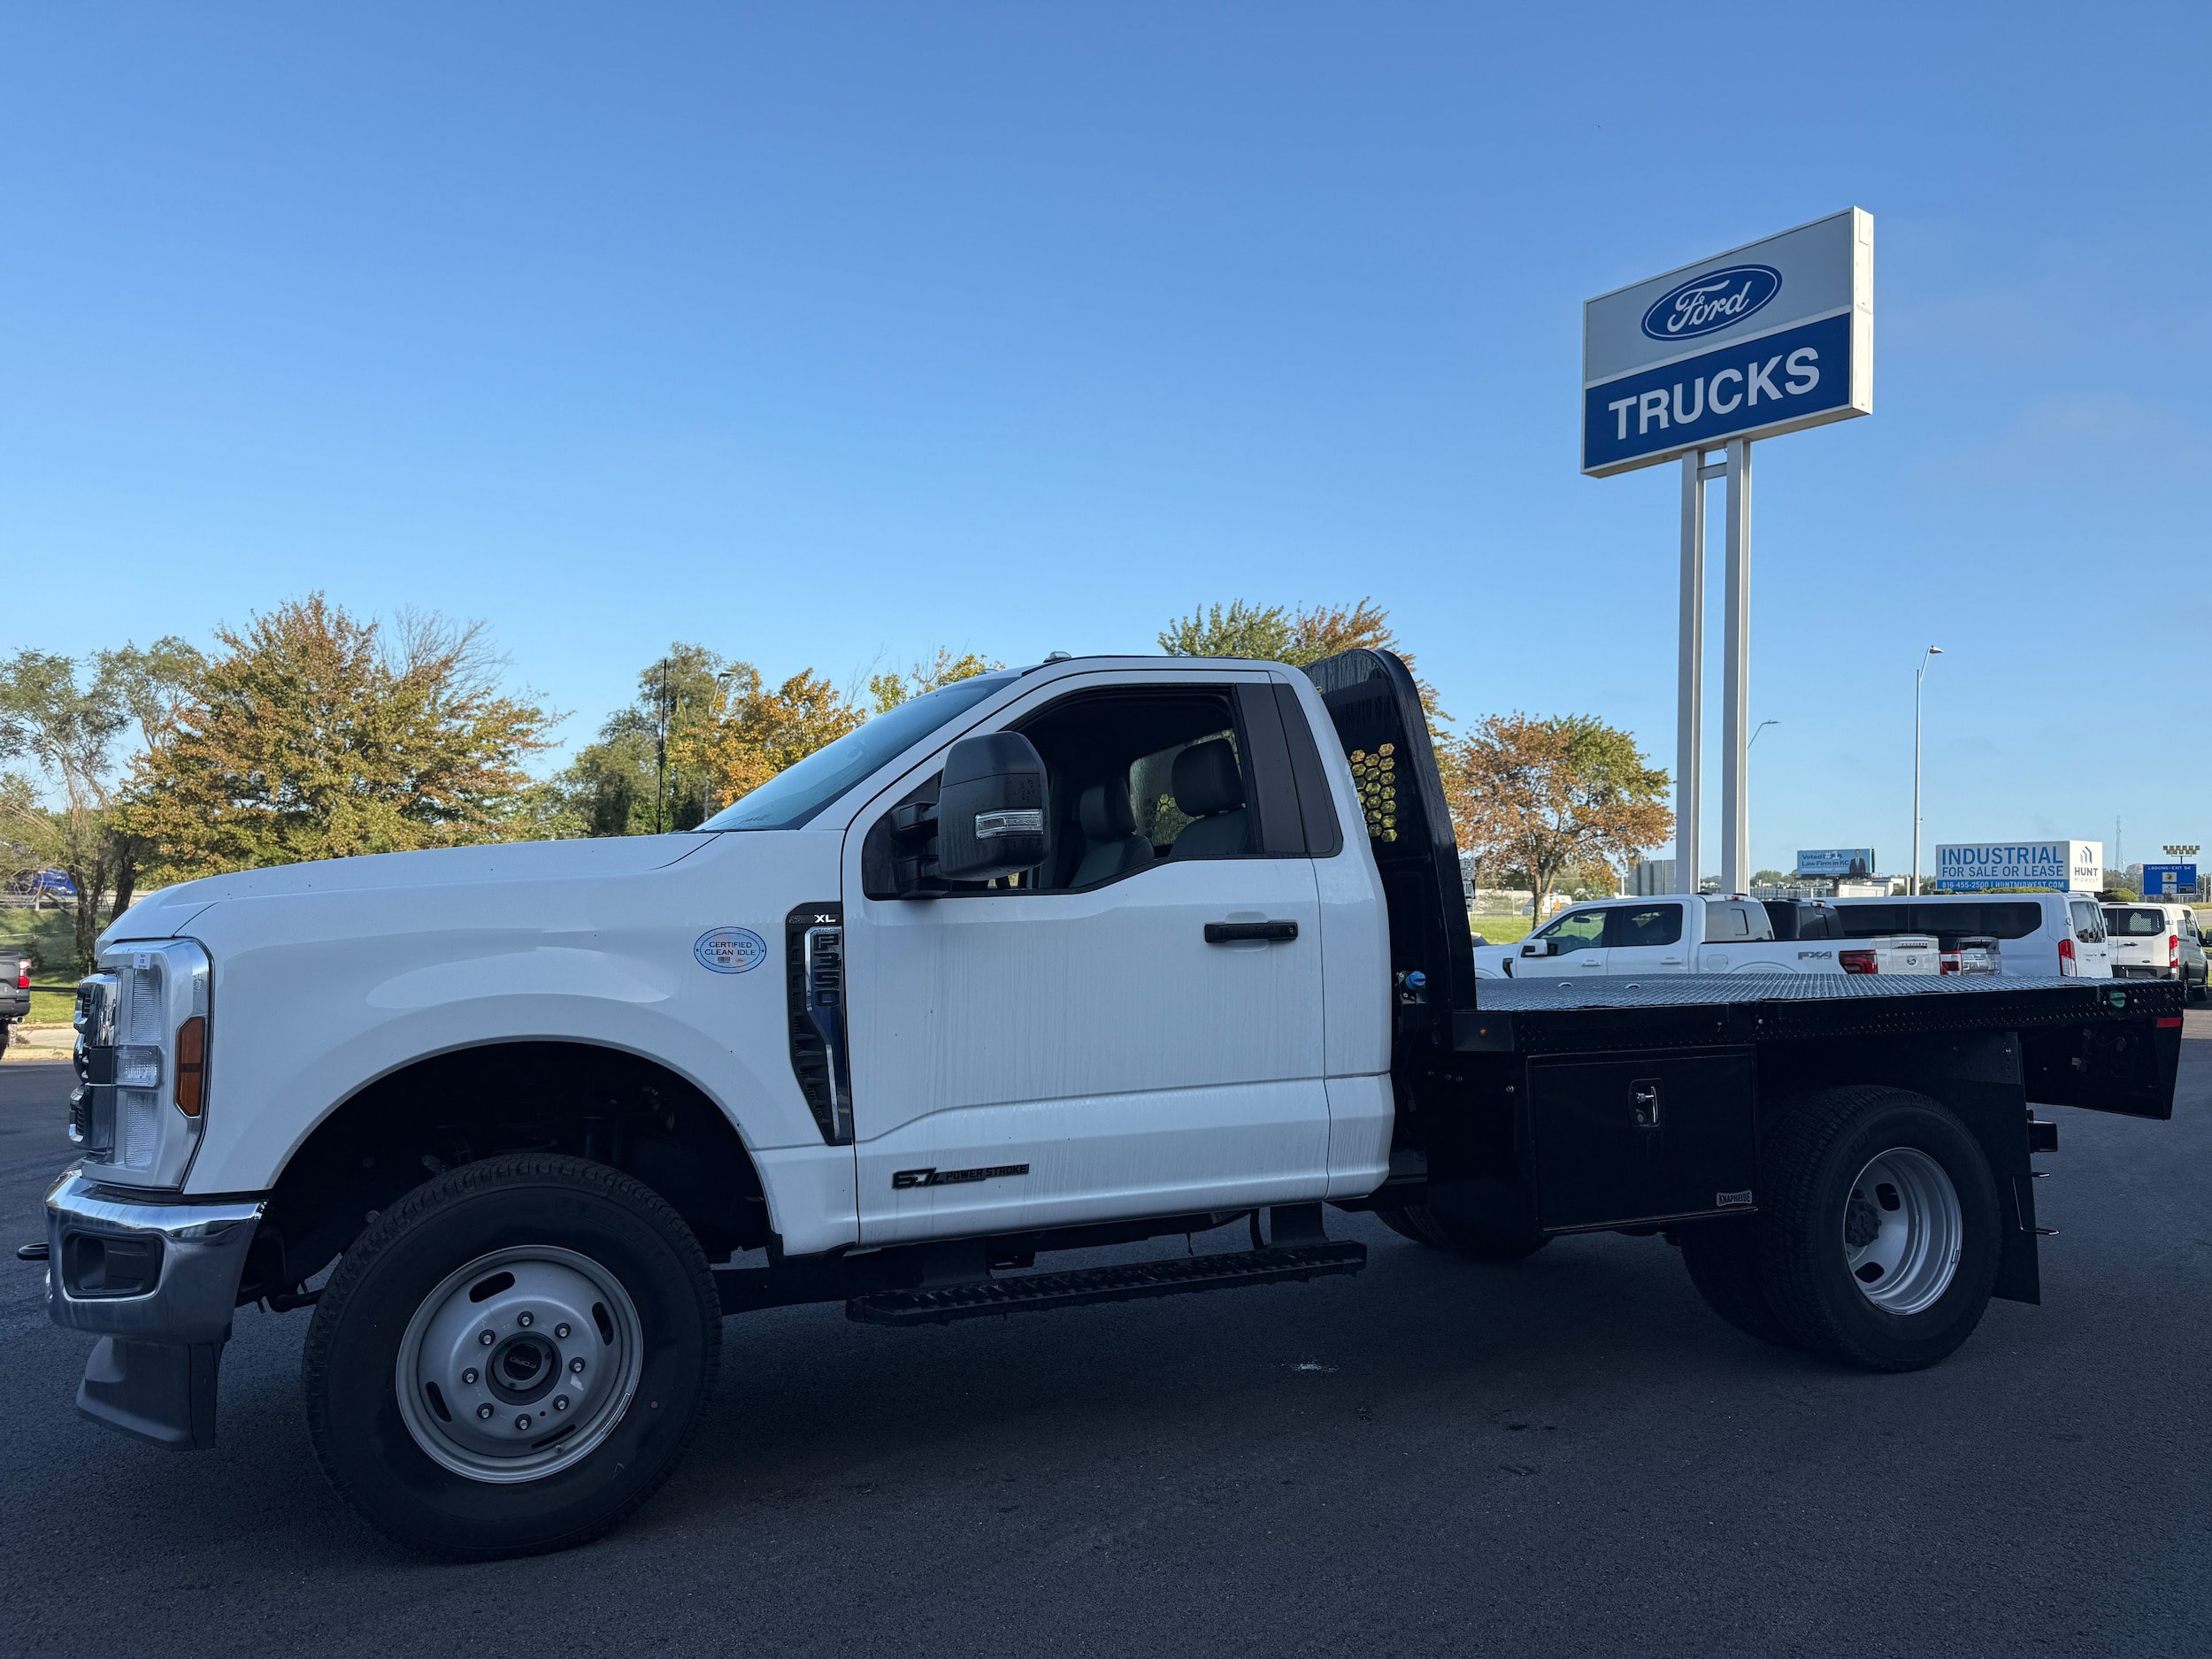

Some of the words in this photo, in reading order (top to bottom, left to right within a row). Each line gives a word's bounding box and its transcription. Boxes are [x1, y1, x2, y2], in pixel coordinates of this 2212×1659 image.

[1666, 280, 1753, 333] Ford
[1608, 347, 1820, 441] TRUCKS
[1942, 846, 2063, 865] INDUSTRIAL
[1942, 866, 1964, 877] FOR
[1969, 866, 1999, 877] SALE
[2002, 866, 2019, 877] OR
[2024, 865, 2063, 877] LEASE
[2074, 866, 2099, 877] HUNT
[814, 914, 836, 923] XL
[1797, 951, 1832, 960] FX4
[946, 1168, 983, 1180] POWER
[986, 1164, 1026, 1177] STROKE
[1718, 1192, 1751, 1205] KNAPHEIDE
